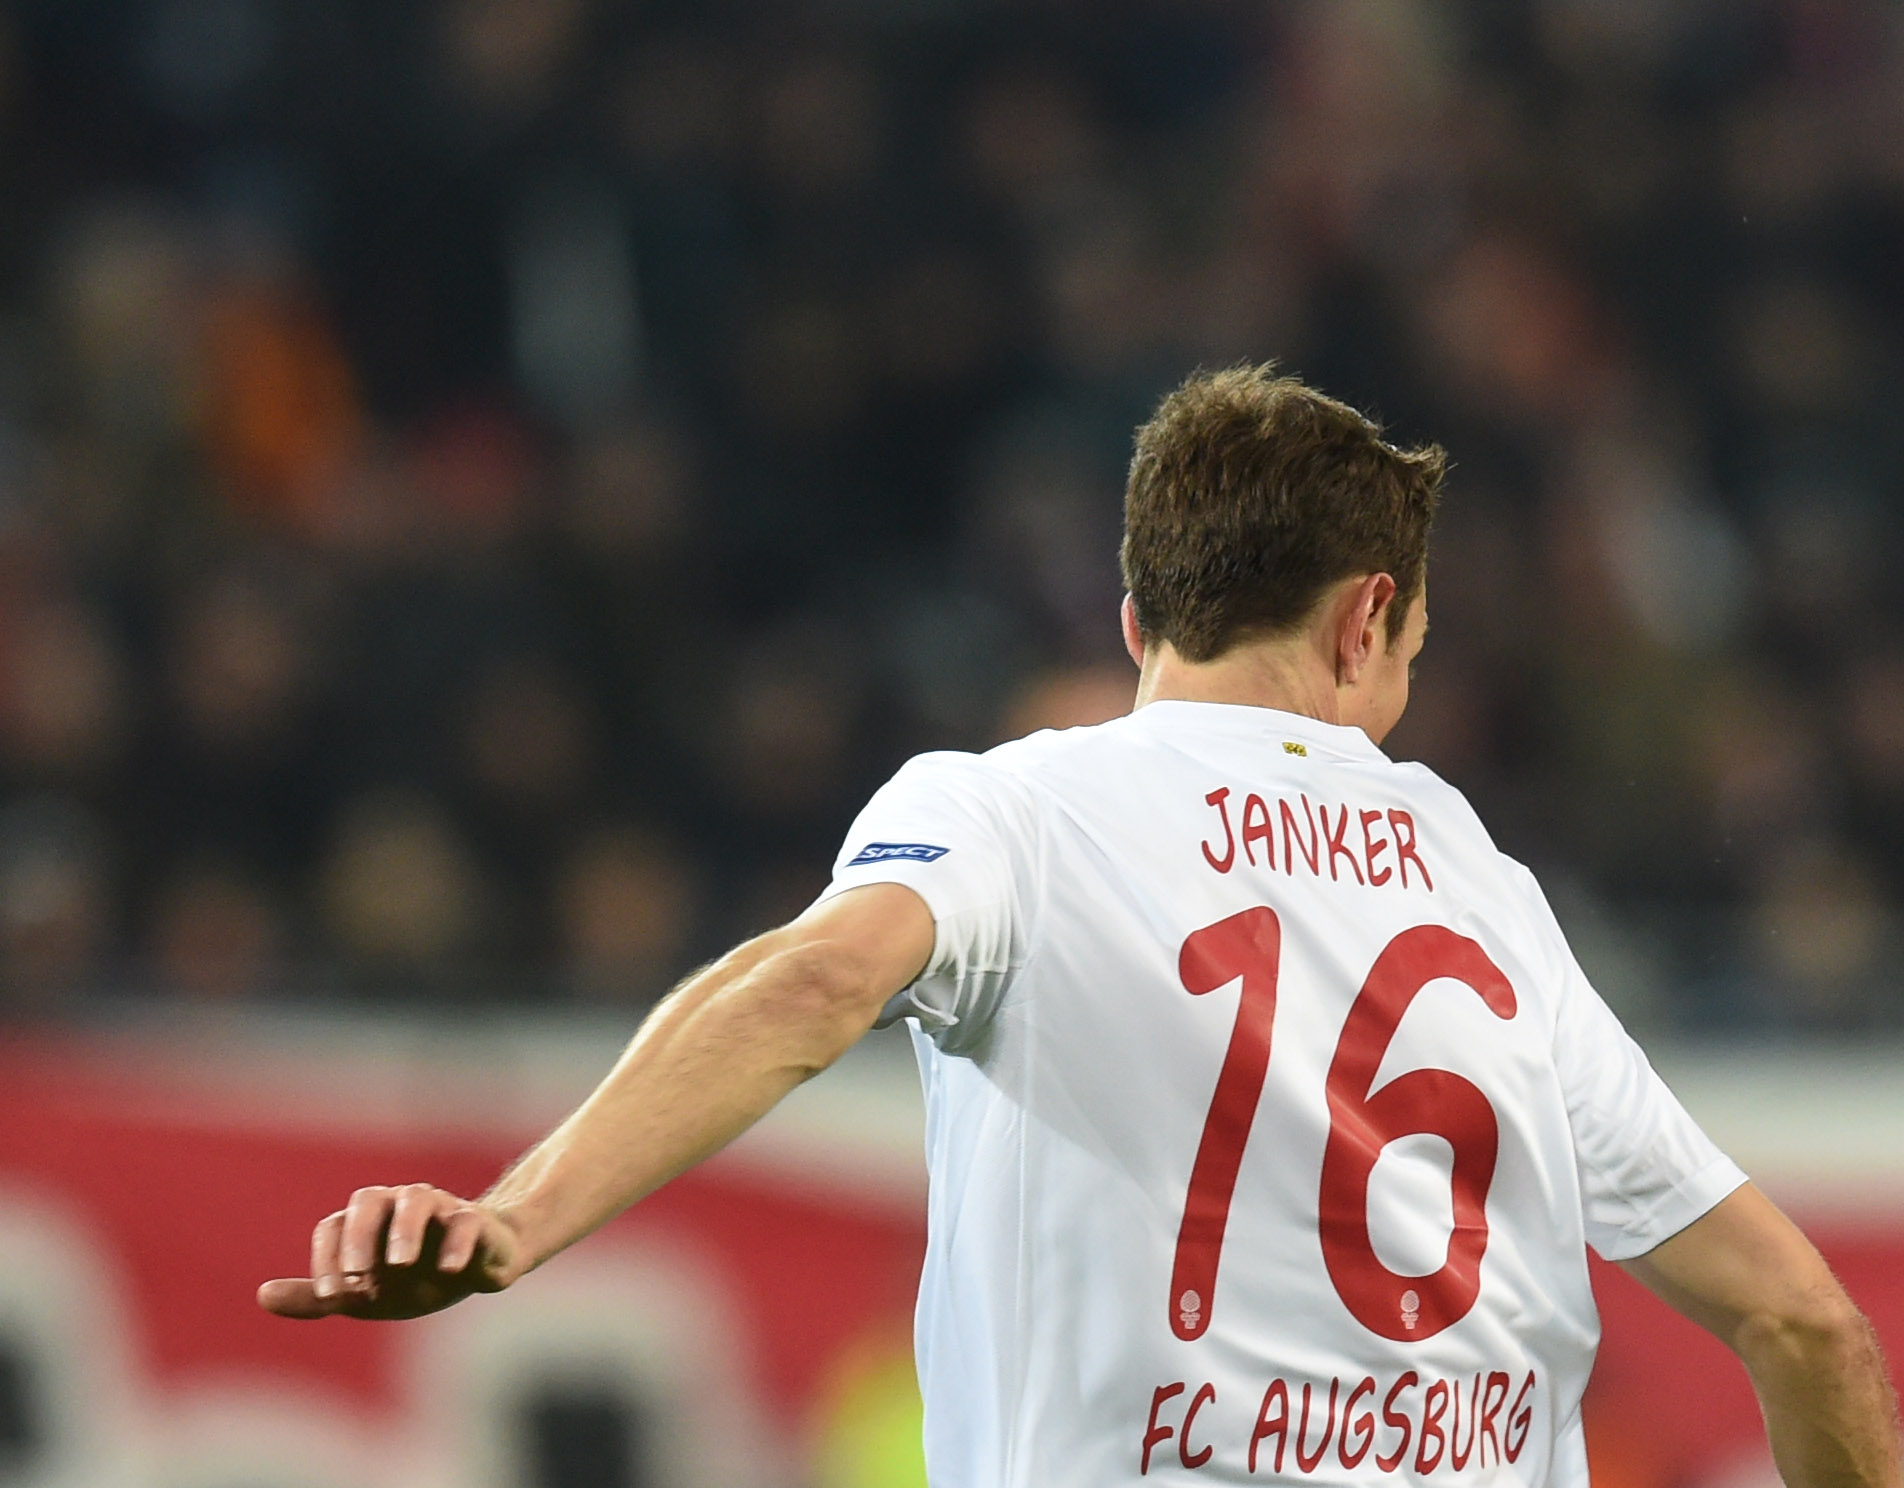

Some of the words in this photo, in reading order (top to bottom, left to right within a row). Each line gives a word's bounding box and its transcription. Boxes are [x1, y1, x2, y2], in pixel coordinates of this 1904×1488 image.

[857, 846, 944, 860] SPECT
[1201, 786, 1433, 892] JANKER
[1168, 905, 1517, 1342] 16
[1140, 1381, 1216, 1475] FC
[1247, 1369, 1536, 1476] AUGSBURG
